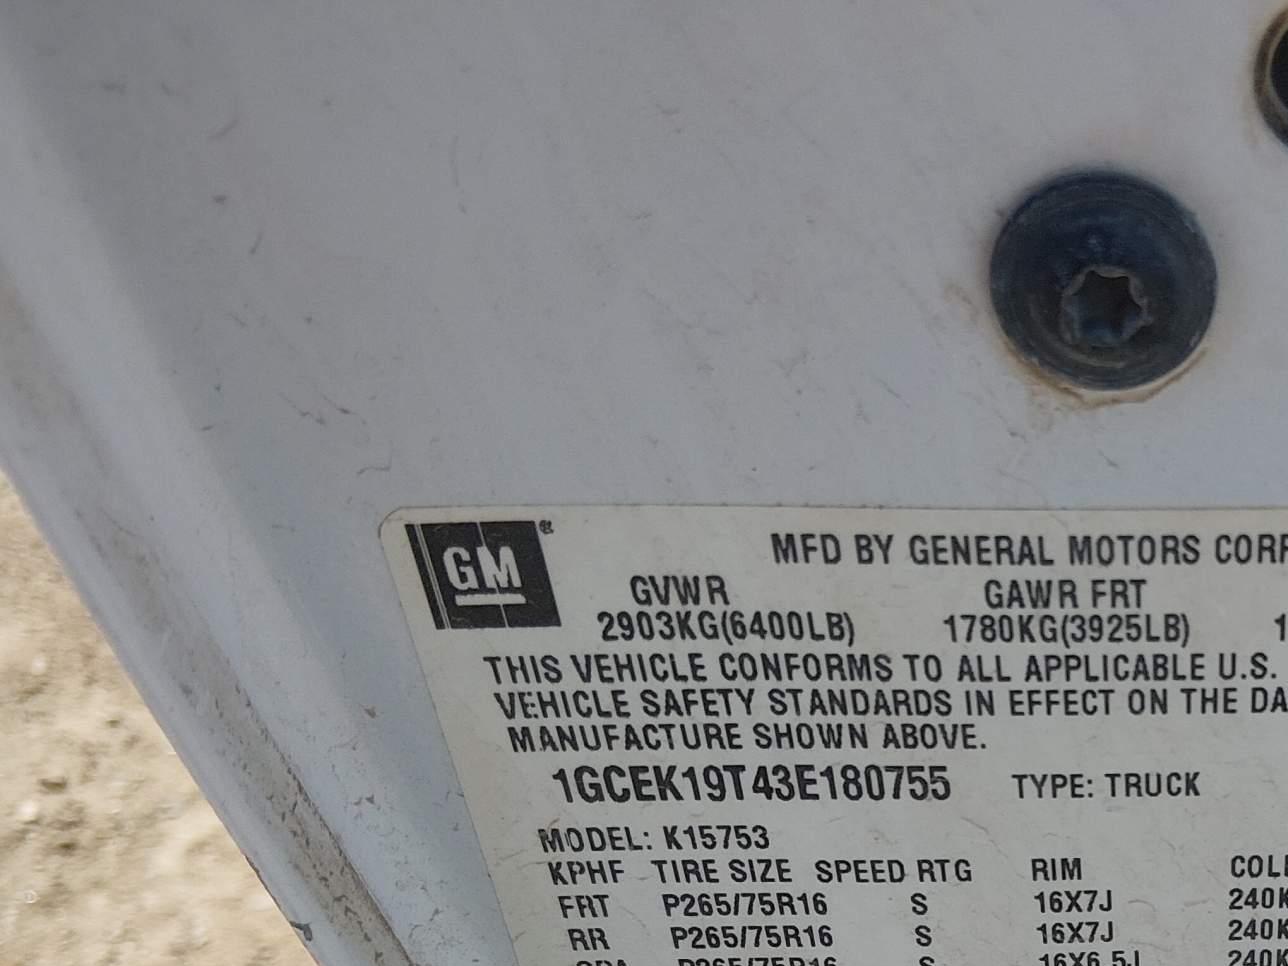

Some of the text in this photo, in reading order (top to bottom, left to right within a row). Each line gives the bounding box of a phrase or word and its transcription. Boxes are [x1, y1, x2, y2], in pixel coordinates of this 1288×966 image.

[771, 534, 841, 564] MFD
[855, 535, 893, 563] BY
[909, 536, 1055, 565] GENERAL
[1069, 536, 1200, 563] MOTORS
[443, 546, 522, 591] GM
[631, 576, 730, 606] GVWR
[984, 579, 1147, 608] GAWR FRT
[597, 612, 856, 645] 2903KG(6400LB)
[942, 613, 1190, 647] 1780KG(3925LB)
[484, 656, 562, 684] THIS
[571, 655, 704, 683] VEHICLE
[719, 654, 892, 681] CONFORMS
[904, 655, 943, 681] TO
[957, 655, 1011, 682] ALL
[1025, 653, 1205, 681] APPLICABLE
[1219, 652, 1280, 679] U.S.
[494, 692, 630, 719] VEHICLE
[642, 690, 755, 717] SAFETY
[770, 690, 951, 716] STANDARDS
[966, 690, 995, 716] IN
[1009, 688, 1114, 715] EFFECT
[1128, 688, 1167, 714] ON
[1182, 687, 1238, 714] THE
[508, 724, 987, 752] MANUFACTURE SHOWN ABOVE.
[552, 765, 951, 803] 1GCEK19T43E180755
[1012, 771, 1201, 799] TYPE: TRUCK
[538, 825, 770, 854] MODEL: K15753
[546, 862, 626, 885] KPHF
[651, 859, 793, 884] TIRE SIZE
[816, 859, 972, 883] SPEED RTG
[1031, 858, 1082, 881] RIM
[557, 895, 610, 919] FRT
[662, 893, 828, 917] P265/75R16
[911, 893, 928, 916] S
[1034, 890, 1113, 913] 16X7J
[568, 928, 611, 951] RR
[670, 926, 834, 949] P265/75R16
[916, 925, 932, 947] S
[1036, 922, 1114, 944] 16X7J
